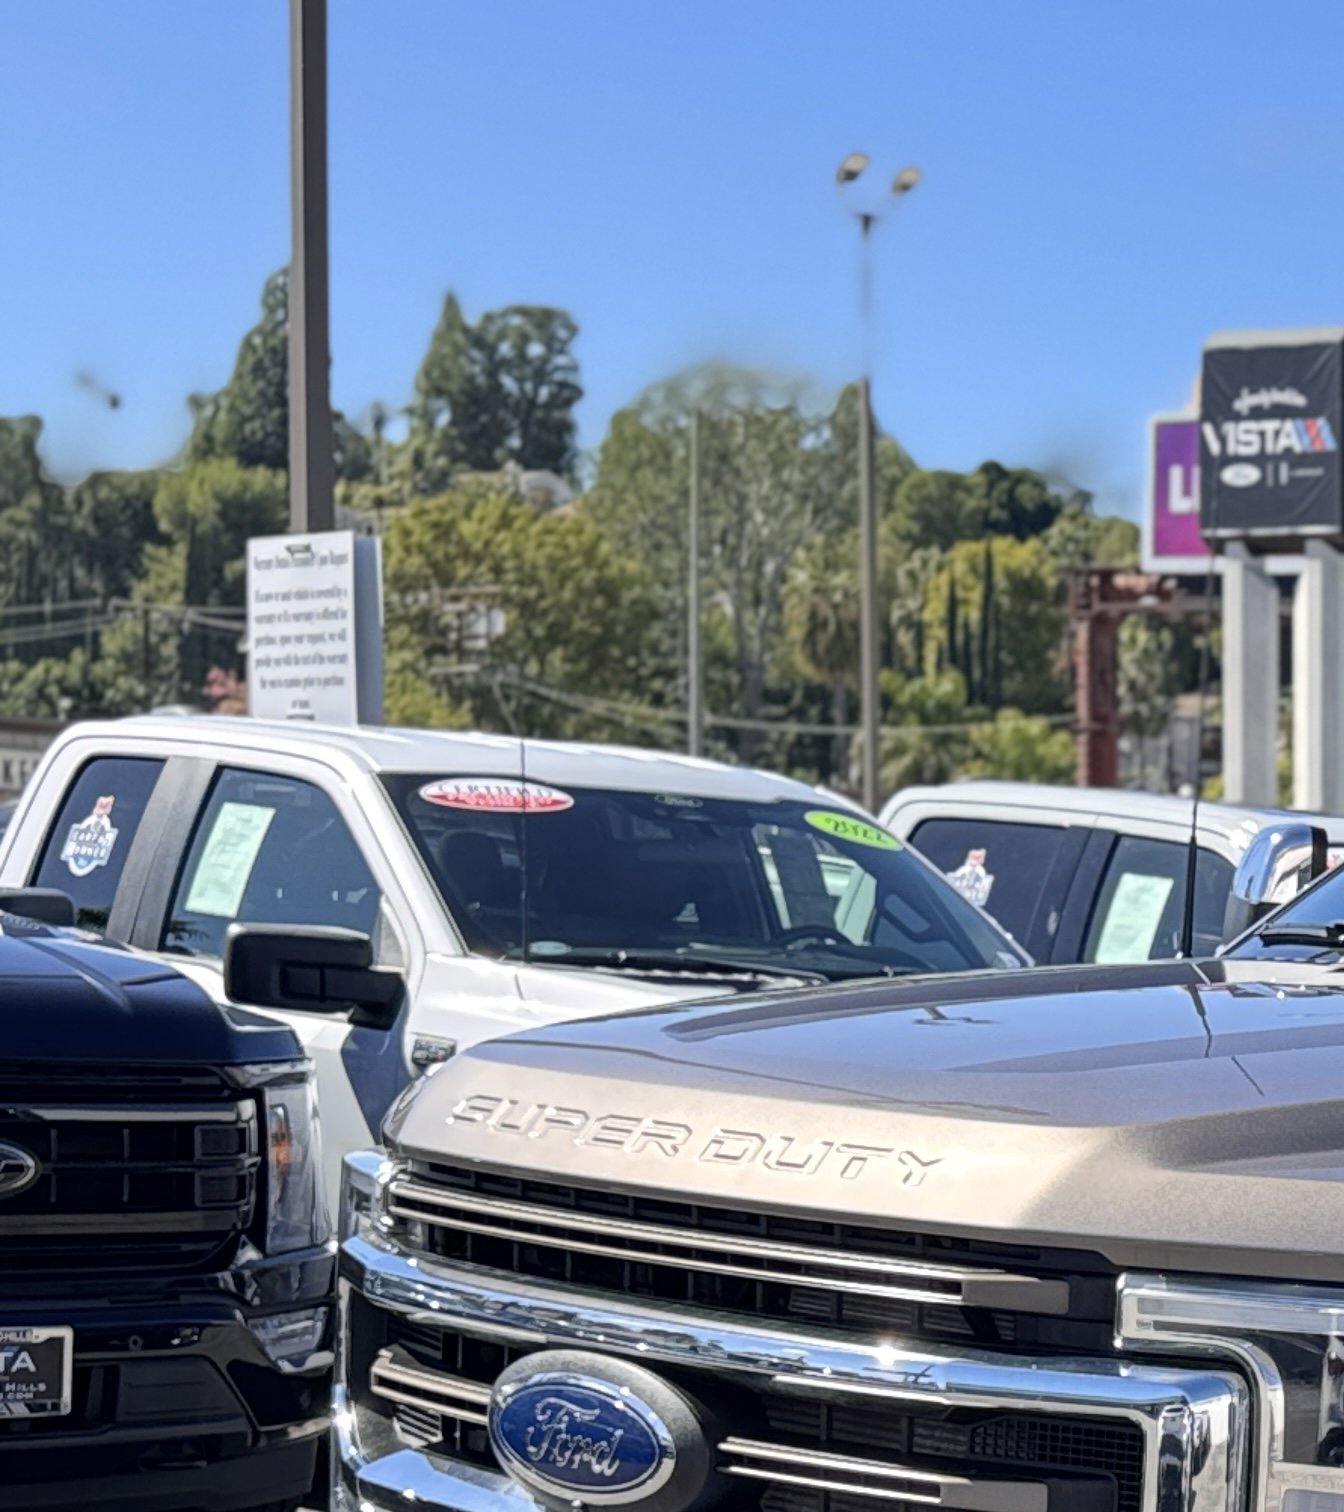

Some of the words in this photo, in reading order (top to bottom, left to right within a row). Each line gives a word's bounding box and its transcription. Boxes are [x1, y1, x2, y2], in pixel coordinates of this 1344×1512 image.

[1202, 420, 1302, 457] VISTA
[447, 1094, 693, 1158] SUPER
[699, 1128, 944, 1188] DUTY
[526, 1397, 626, 1477] Ford
